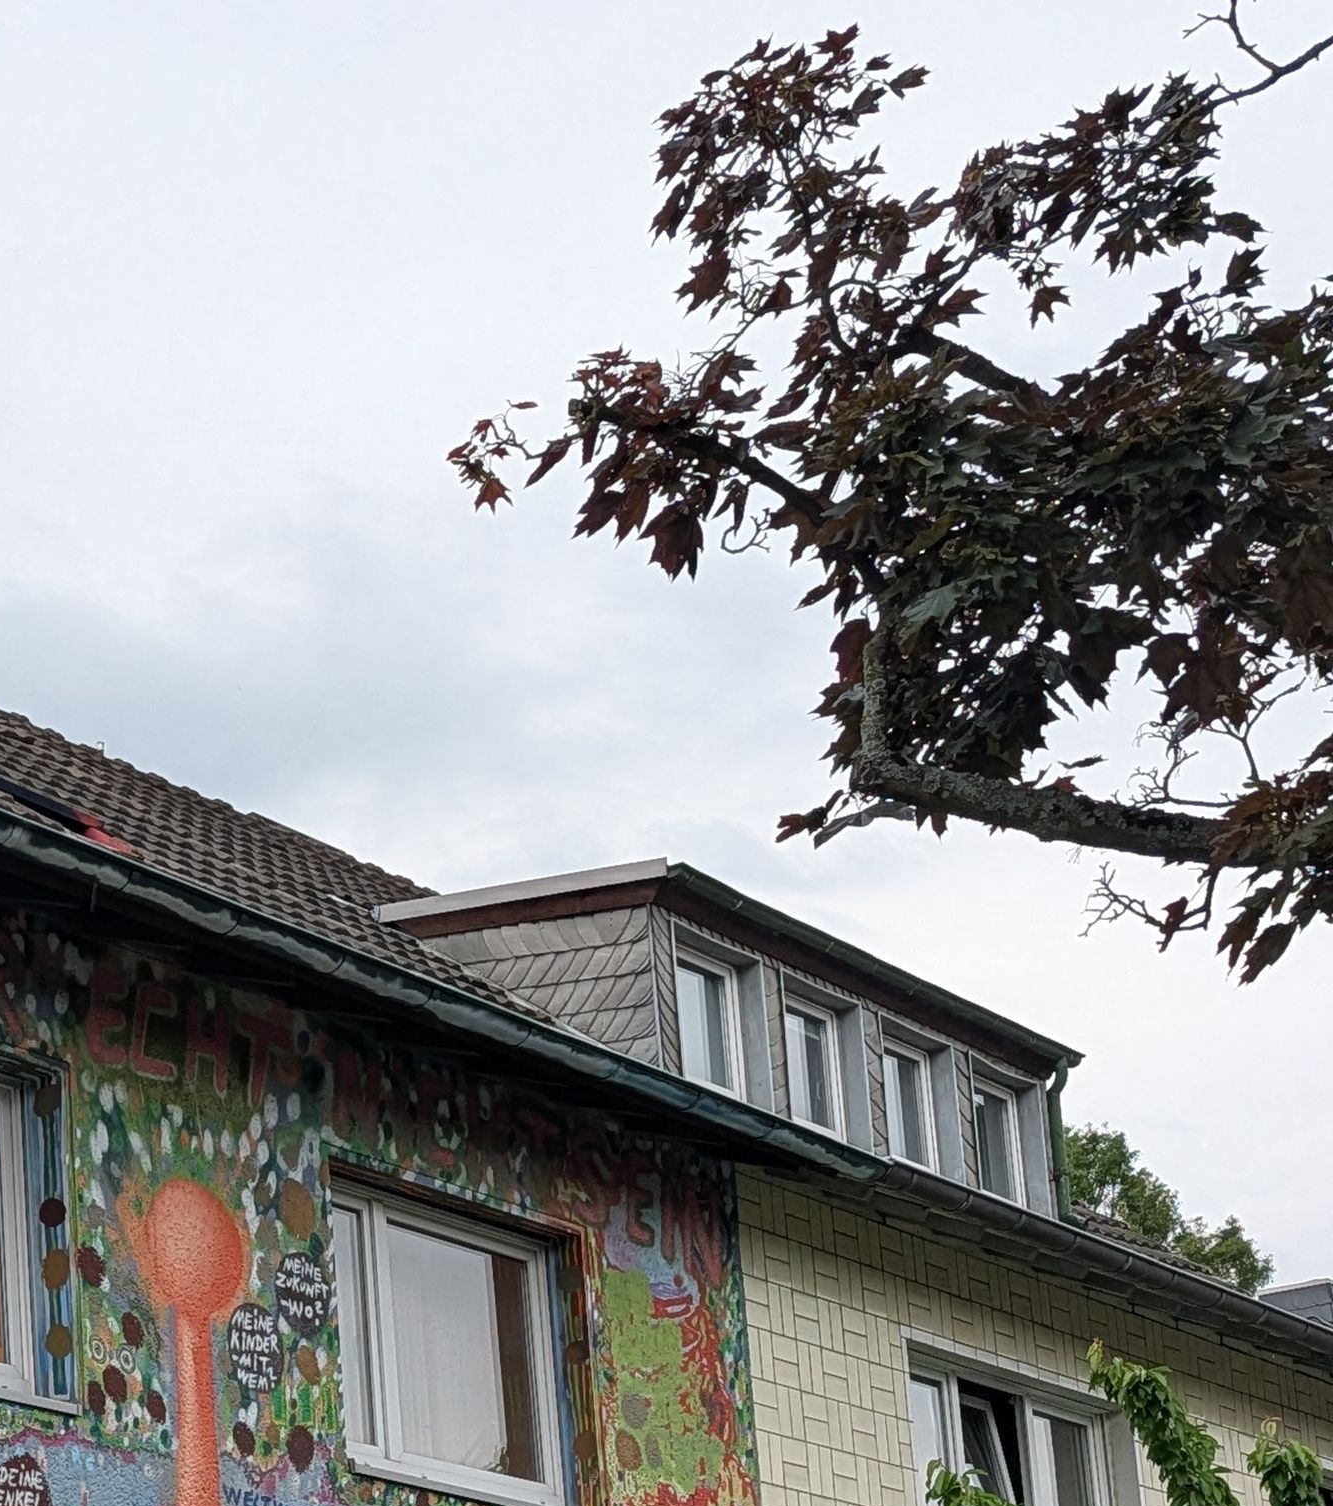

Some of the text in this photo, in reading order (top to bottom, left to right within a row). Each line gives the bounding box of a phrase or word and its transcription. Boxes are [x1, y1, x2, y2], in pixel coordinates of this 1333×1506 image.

[283, 1257, 322, 1283] MEINE
[277, 1273, 328, 1299] ZUKUNFT
[234, 1308, 274, 1334] MEINE
[230, 1330, 279, 1353] KINDER
